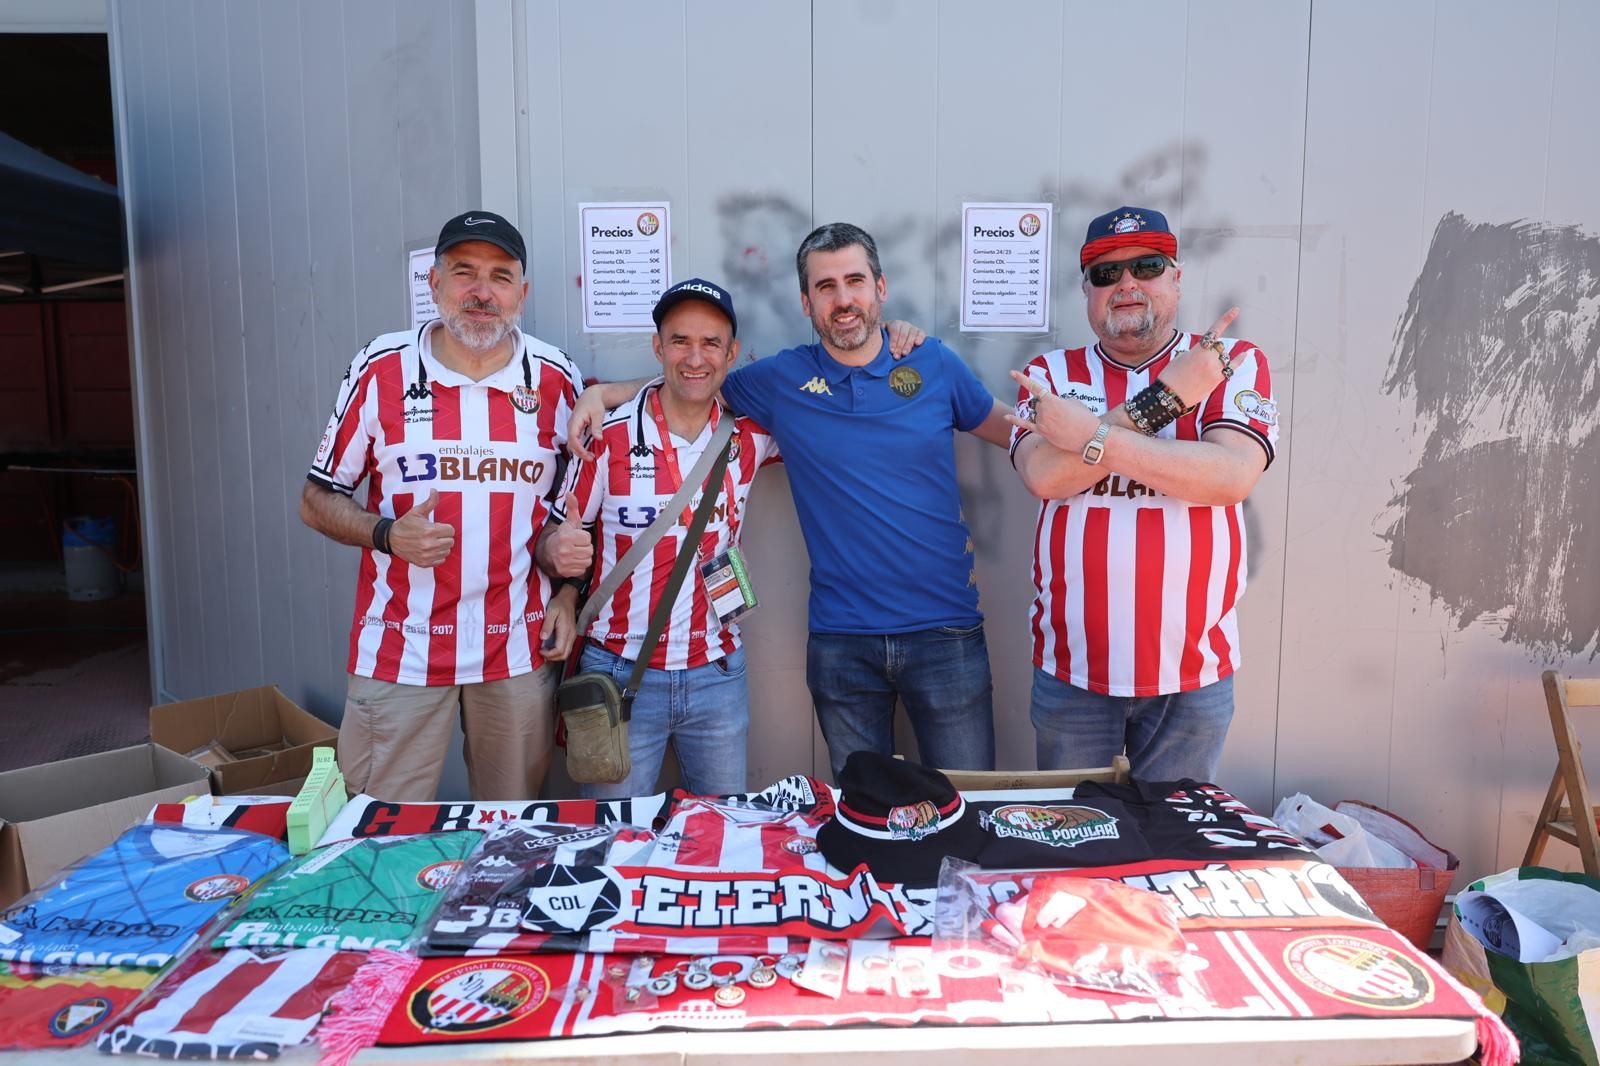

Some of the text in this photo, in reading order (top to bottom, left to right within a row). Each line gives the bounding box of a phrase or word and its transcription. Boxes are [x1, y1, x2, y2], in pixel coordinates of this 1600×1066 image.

[591, 226, 633, 237] Precios
[973, 226, 1015, 237] Precios
[439, 445, 494, 456] embalajes
[440, 457, 544, 484] BLANCO
[432, 625, 454, 635] 2017
[487, 624, 508, 634] 2016
[526, 611, 544, 623] 2014
[524, 825, 610, 849] Kappa
[1052, 823, 1114, 840] POPULAR
[548, 896, 586, 911] CDL
[285, 904, 418, 924] Kappa
